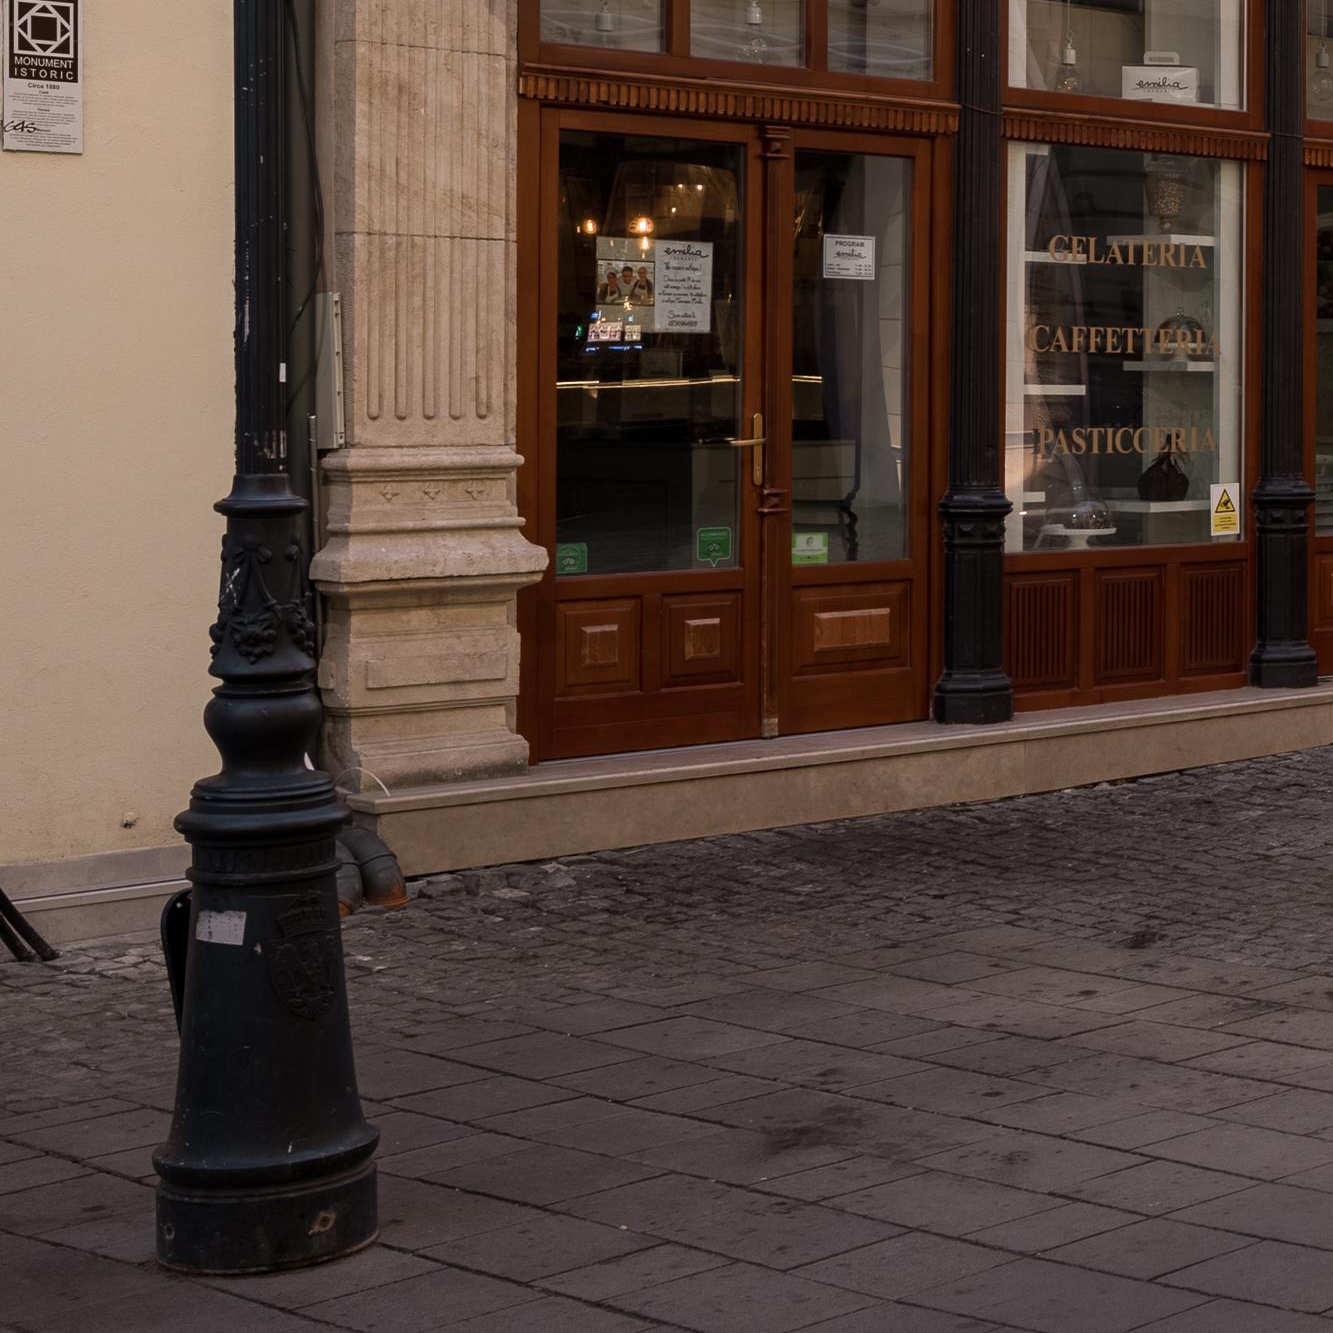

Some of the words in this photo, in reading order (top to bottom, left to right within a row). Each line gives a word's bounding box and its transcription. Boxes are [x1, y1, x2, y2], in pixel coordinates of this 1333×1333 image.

[14, 56, 74, 69] MONUMENT
[14, 67, 74, 80] ISTORIC
[1136, 77, 1189, 90] emilia
[664, 245, 709, 258] emilia
[1049, 234, 1207, 268] GELATERIA
[1031, 325, 1221, 357] CAFFETTERIA
[1039, 426, 1217, 455] PASTICCERIA
